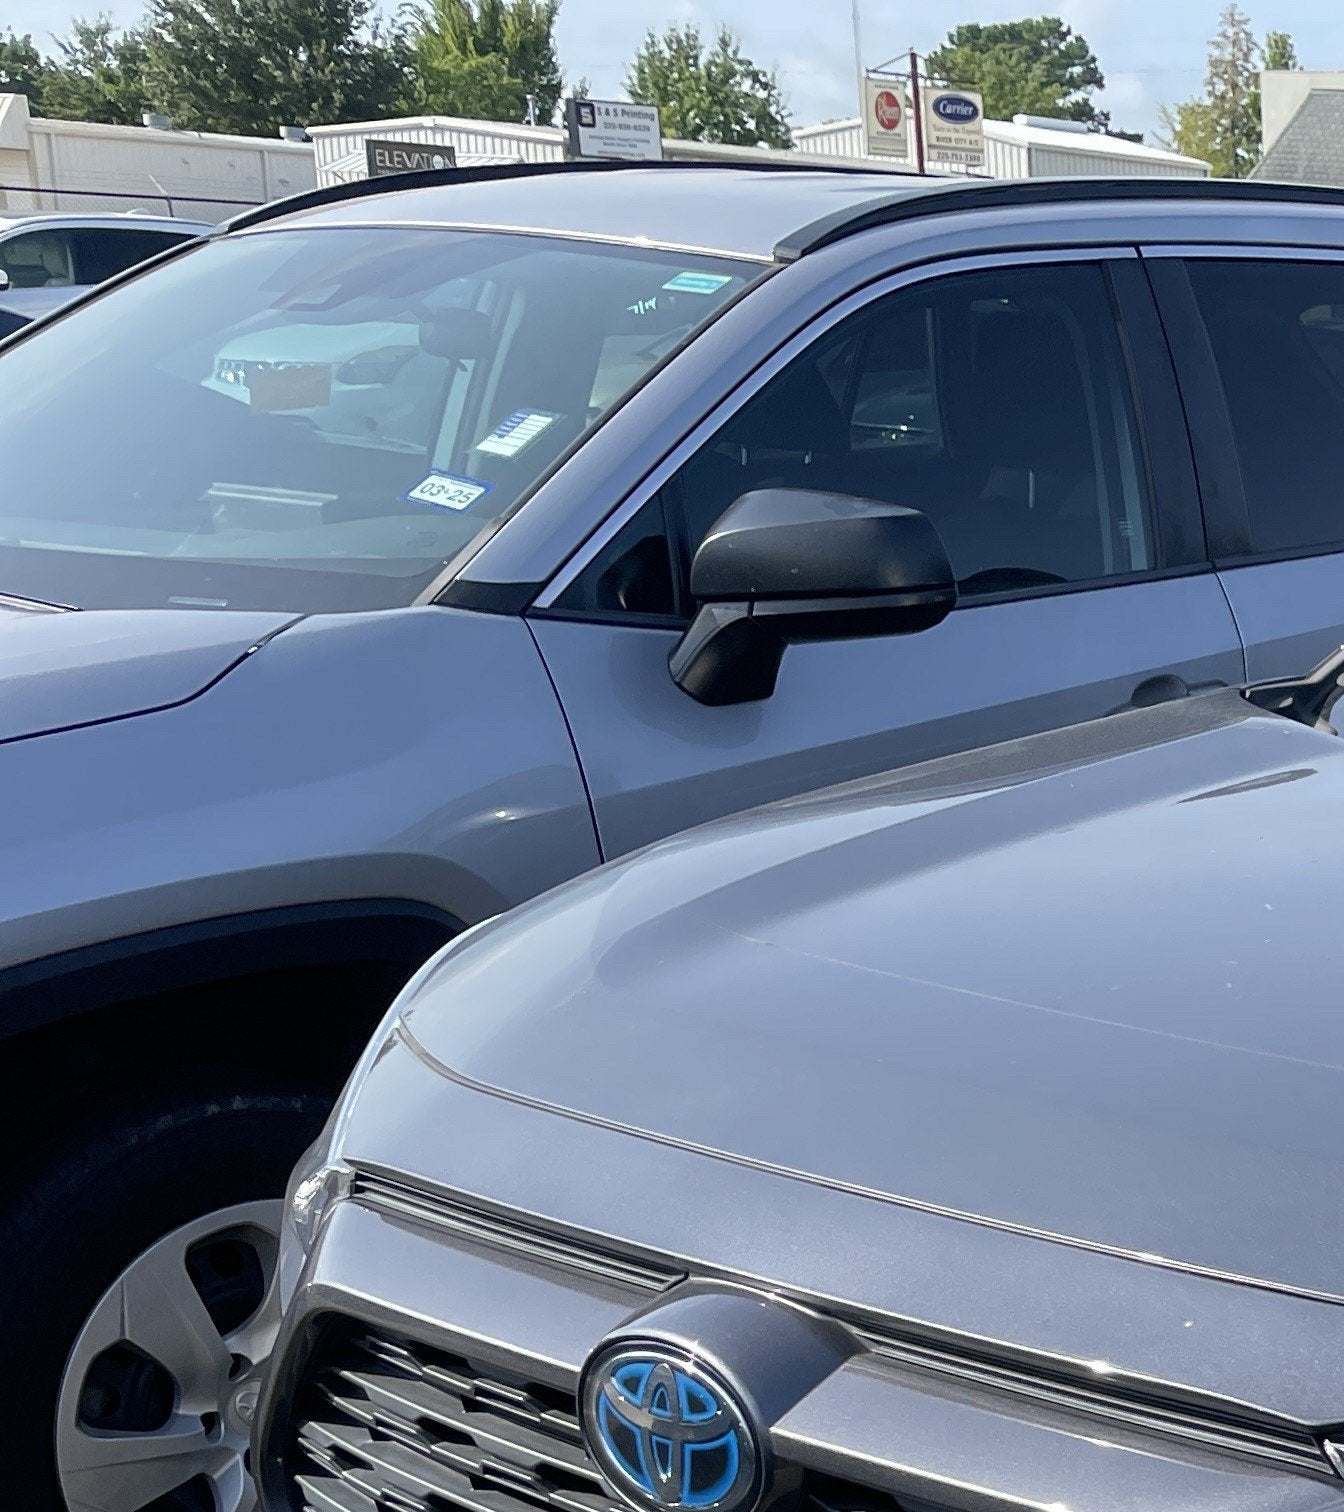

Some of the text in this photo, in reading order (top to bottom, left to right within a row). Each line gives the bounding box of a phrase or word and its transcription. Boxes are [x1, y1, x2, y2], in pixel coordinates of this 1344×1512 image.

[621, 109, 655, 122] Printing
[939, 100, 974, 116] Carrier
[375, 148, 456, 170] ELEVATION
[420, 482, 446, 497] 03
[446, 489, 475, 504] 25
